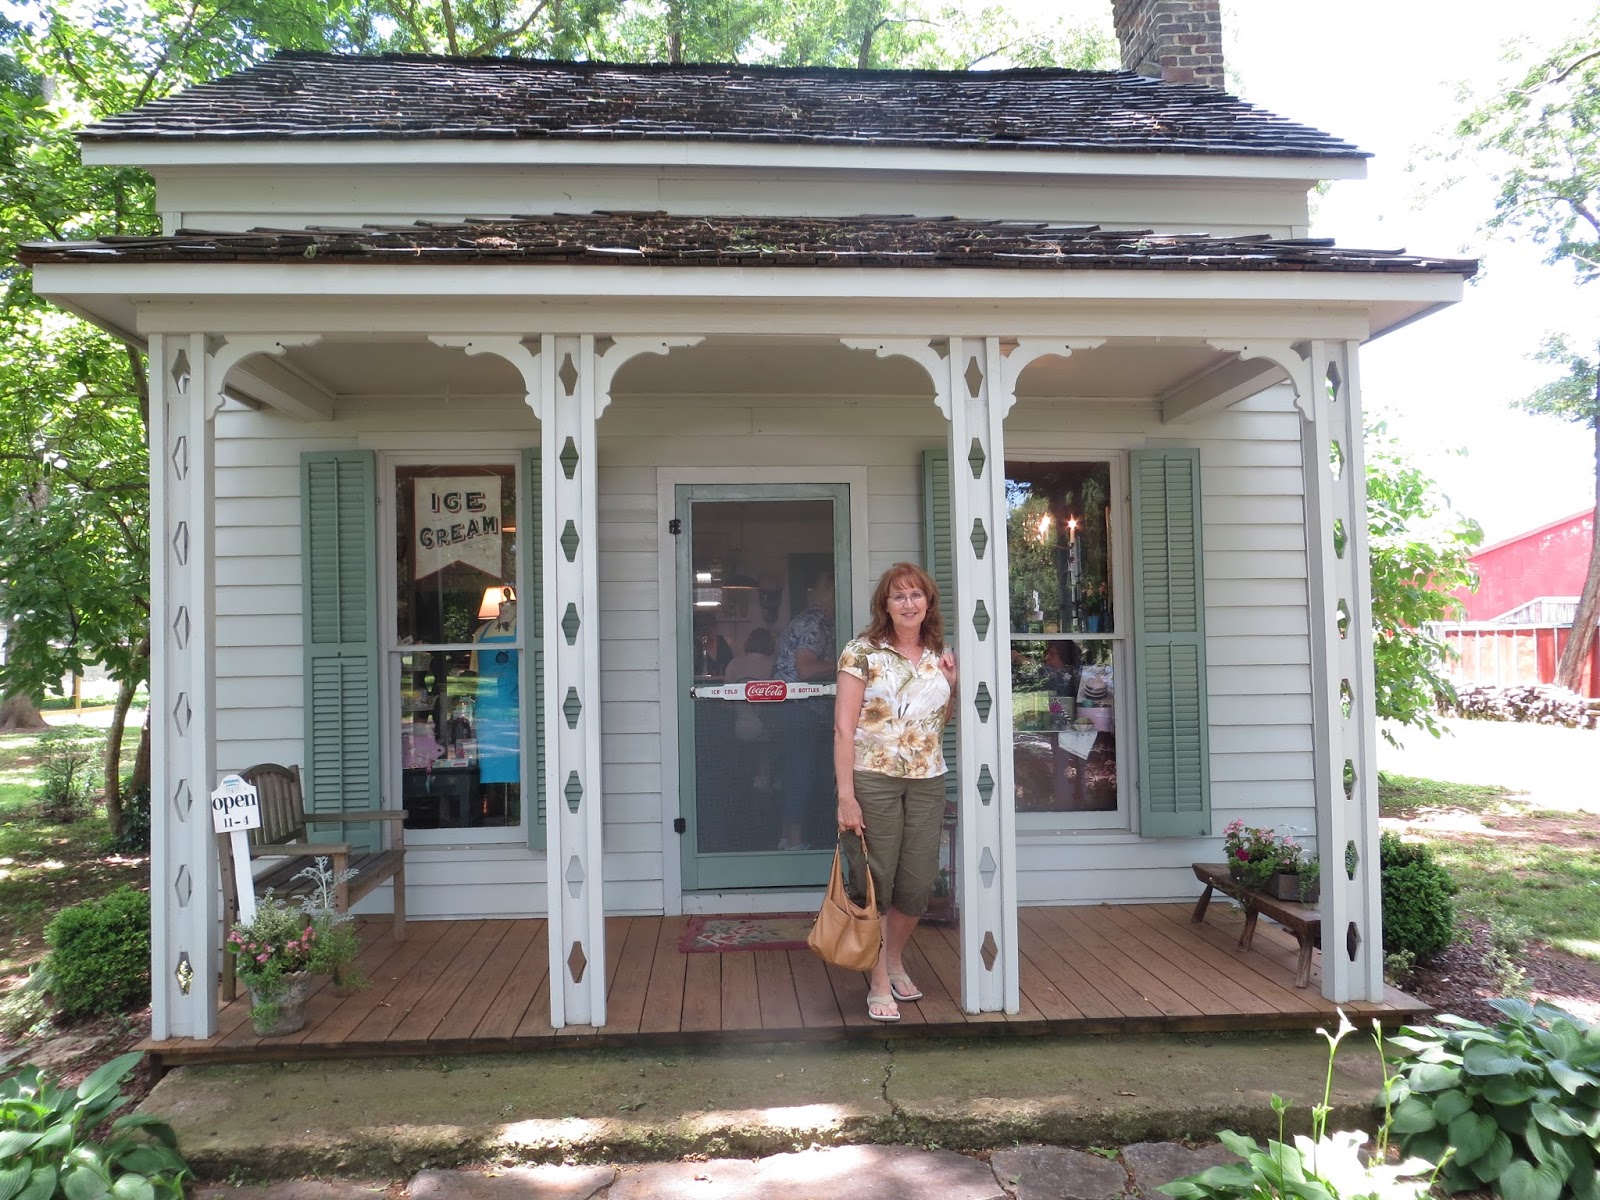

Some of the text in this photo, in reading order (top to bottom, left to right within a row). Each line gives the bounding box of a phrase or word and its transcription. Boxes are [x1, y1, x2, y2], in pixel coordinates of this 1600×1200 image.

[430, 492, 486, 513] ICE
[420, 516, 499, 550] CREAM
[747, 684, 784, 696] Coca-Cola
[212, 793, 257, 815] open
